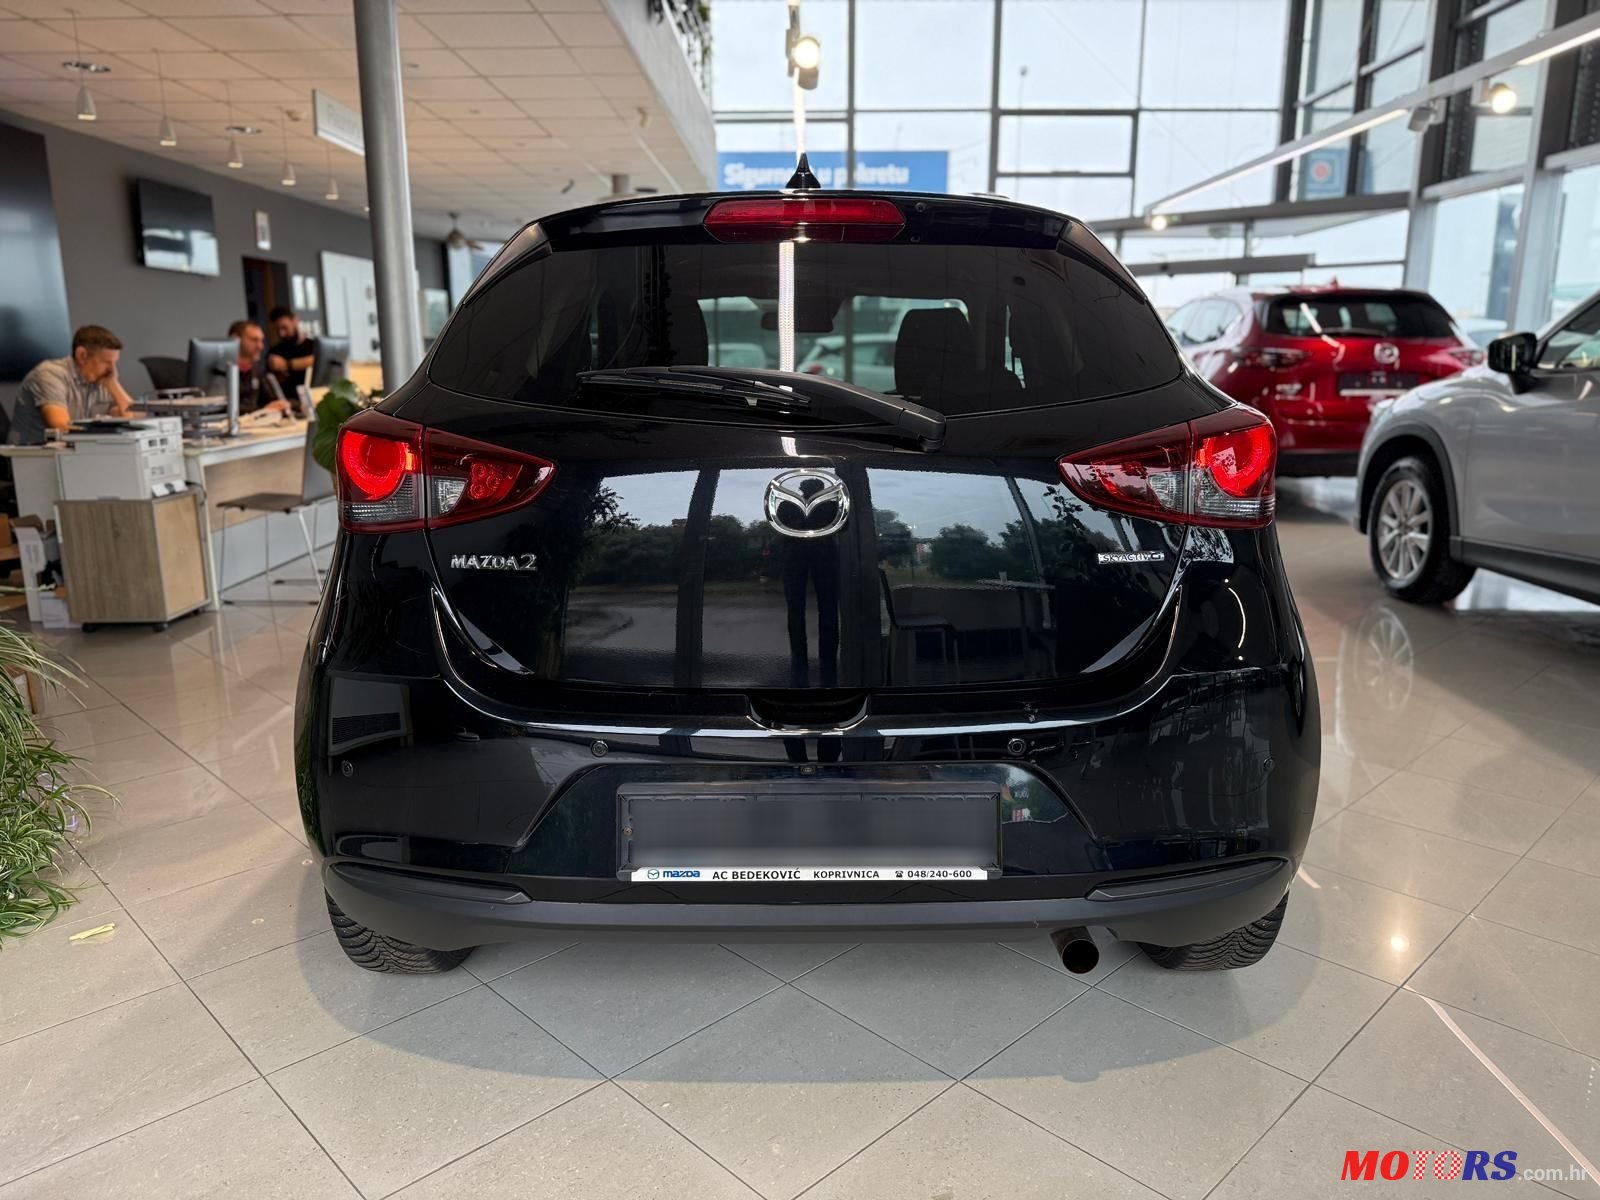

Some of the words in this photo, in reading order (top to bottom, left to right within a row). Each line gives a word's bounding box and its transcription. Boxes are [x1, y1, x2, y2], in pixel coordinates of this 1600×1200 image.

[834, 163, 909, 188] pkretu
[662, 870, 701, 878] mazda
[712, 871, 728, 880] AC
[731, 868, 801, 880] BEDEKOVIĆ
[813, 870, 880, 879] KOPRIVNICA
[907, 870, 972, 878] 048/240-600
